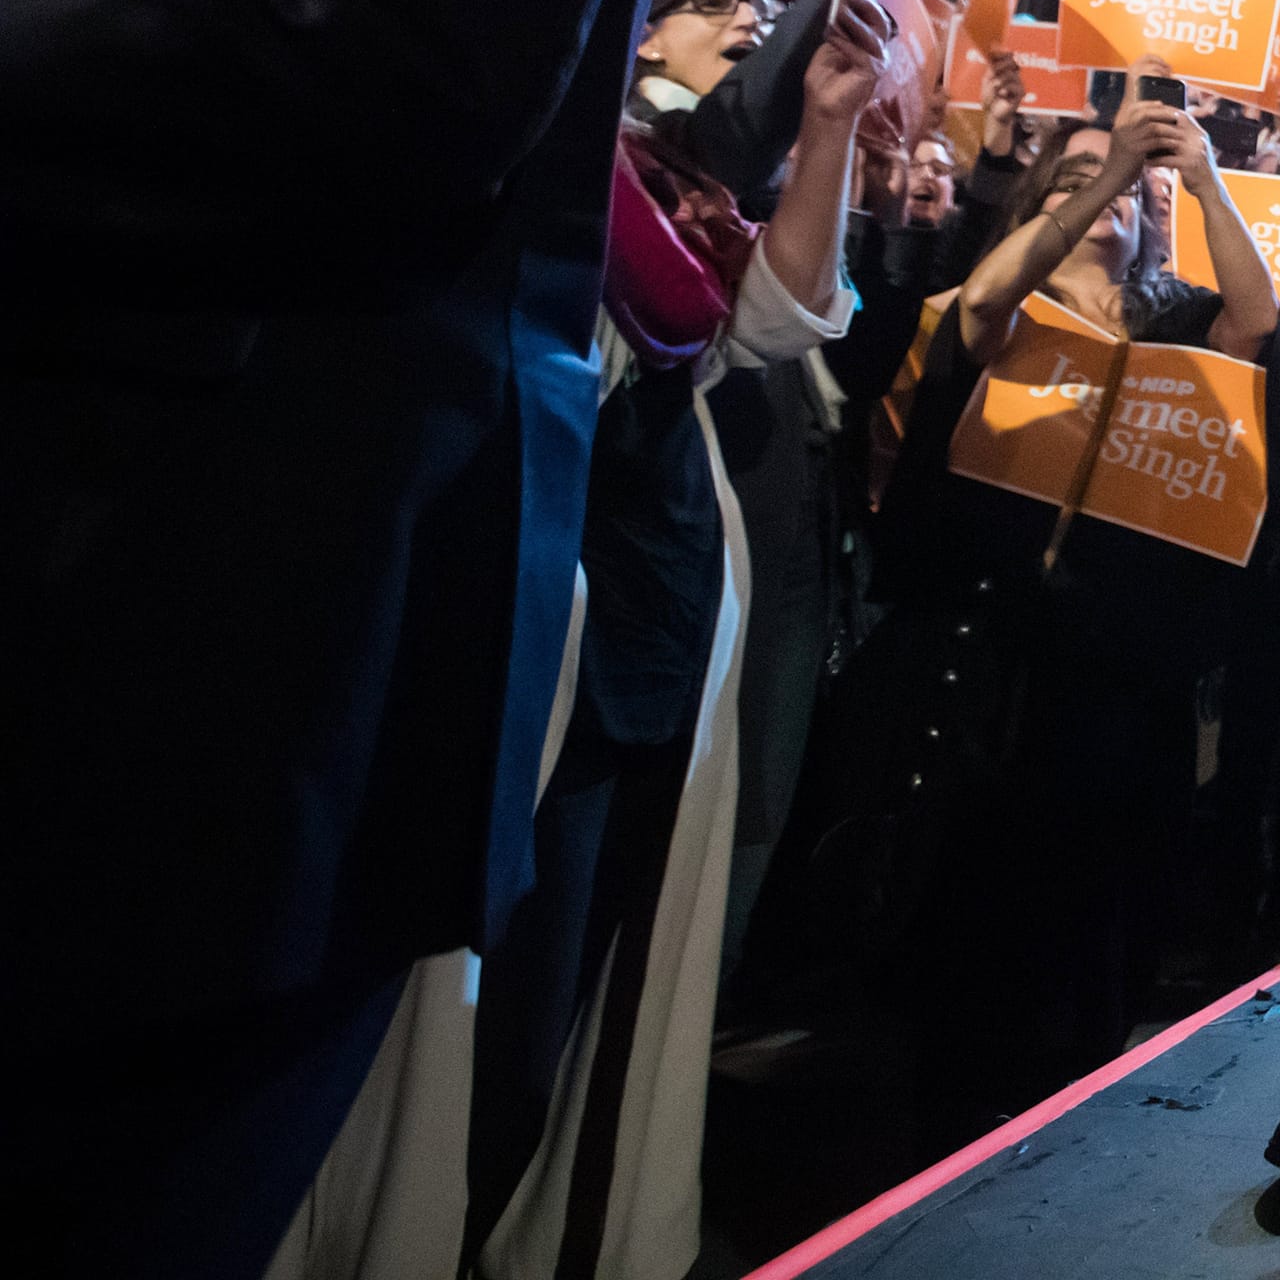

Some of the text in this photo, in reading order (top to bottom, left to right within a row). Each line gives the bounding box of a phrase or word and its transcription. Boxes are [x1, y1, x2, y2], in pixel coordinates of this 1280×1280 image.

[1143, 9, 1239, 54] Singh
[1139, 377, 1195, 396] NDP
[1101, 429, 1227, 501] Singh
